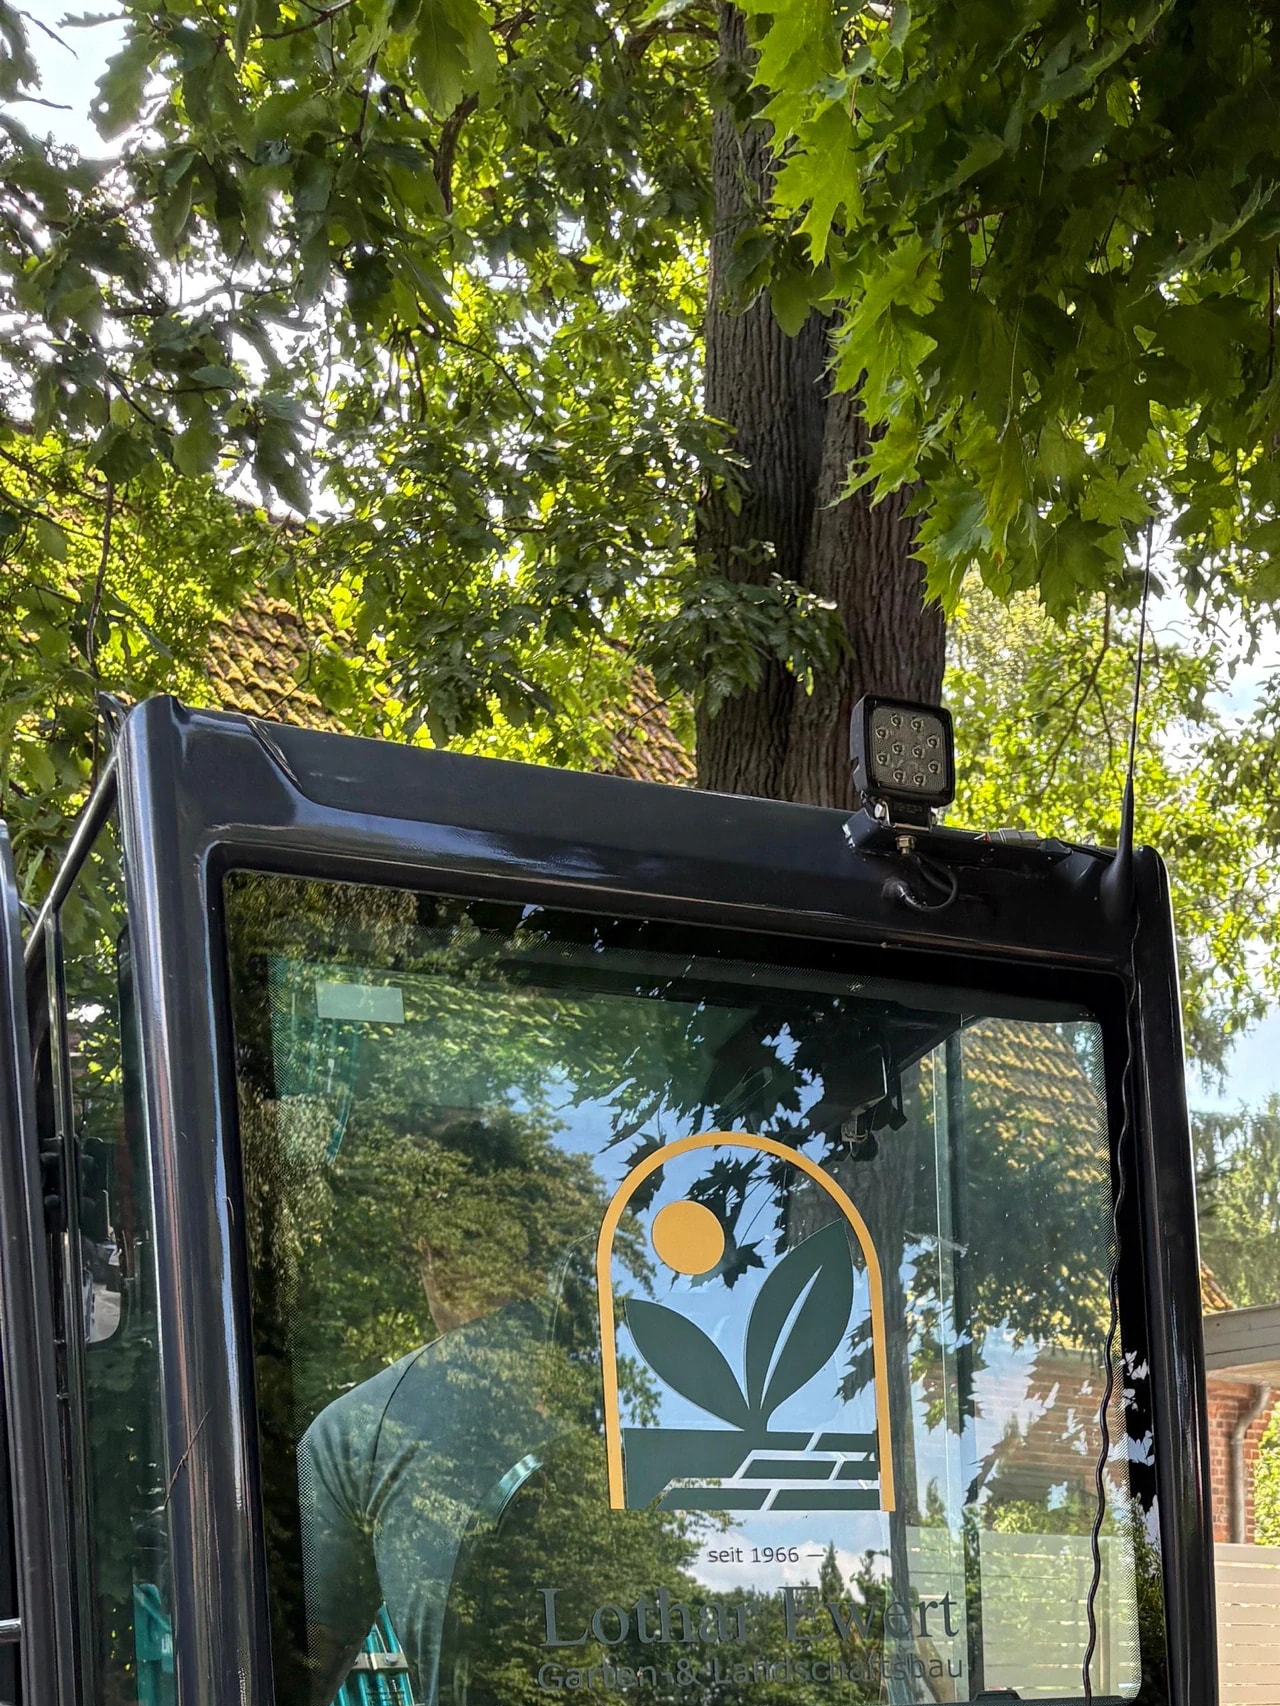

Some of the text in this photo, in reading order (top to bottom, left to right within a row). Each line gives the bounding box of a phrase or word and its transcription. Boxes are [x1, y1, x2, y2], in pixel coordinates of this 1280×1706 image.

[708, 1546, 799, 1563] seit 1966
[536, 1586, 960, 1648] Lothar Ewert
[713, 1653, 963, 1685] Landschaftsbau
